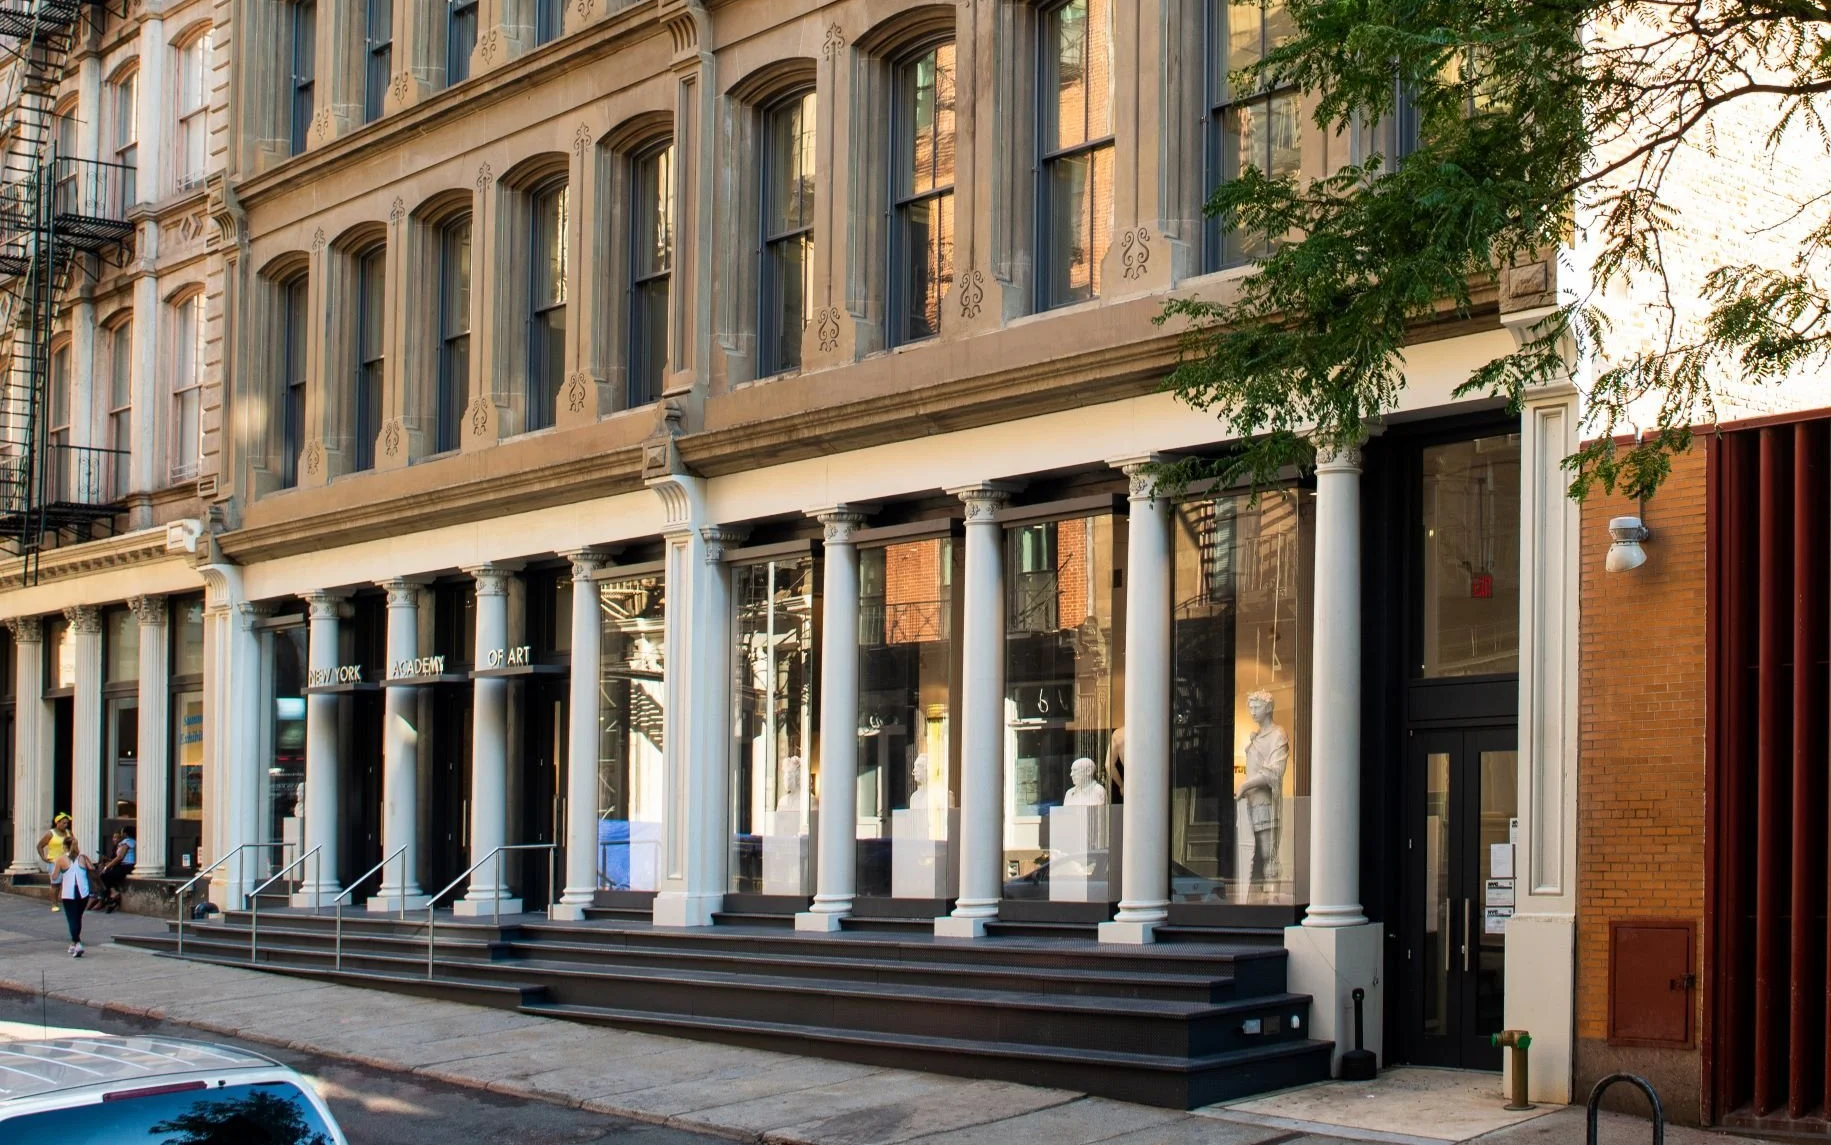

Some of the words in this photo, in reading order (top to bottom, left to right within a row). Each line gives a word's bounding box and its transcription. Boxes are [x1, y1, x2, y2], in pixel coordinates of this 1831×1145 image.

[393, 656, 444, 677] ACADEMY
[488, 649, 504, 666] OF
[507, 646, 530, 664] ART
[310, 668, 332, 686] NEW
[334, 665, 361, 682] YORK
